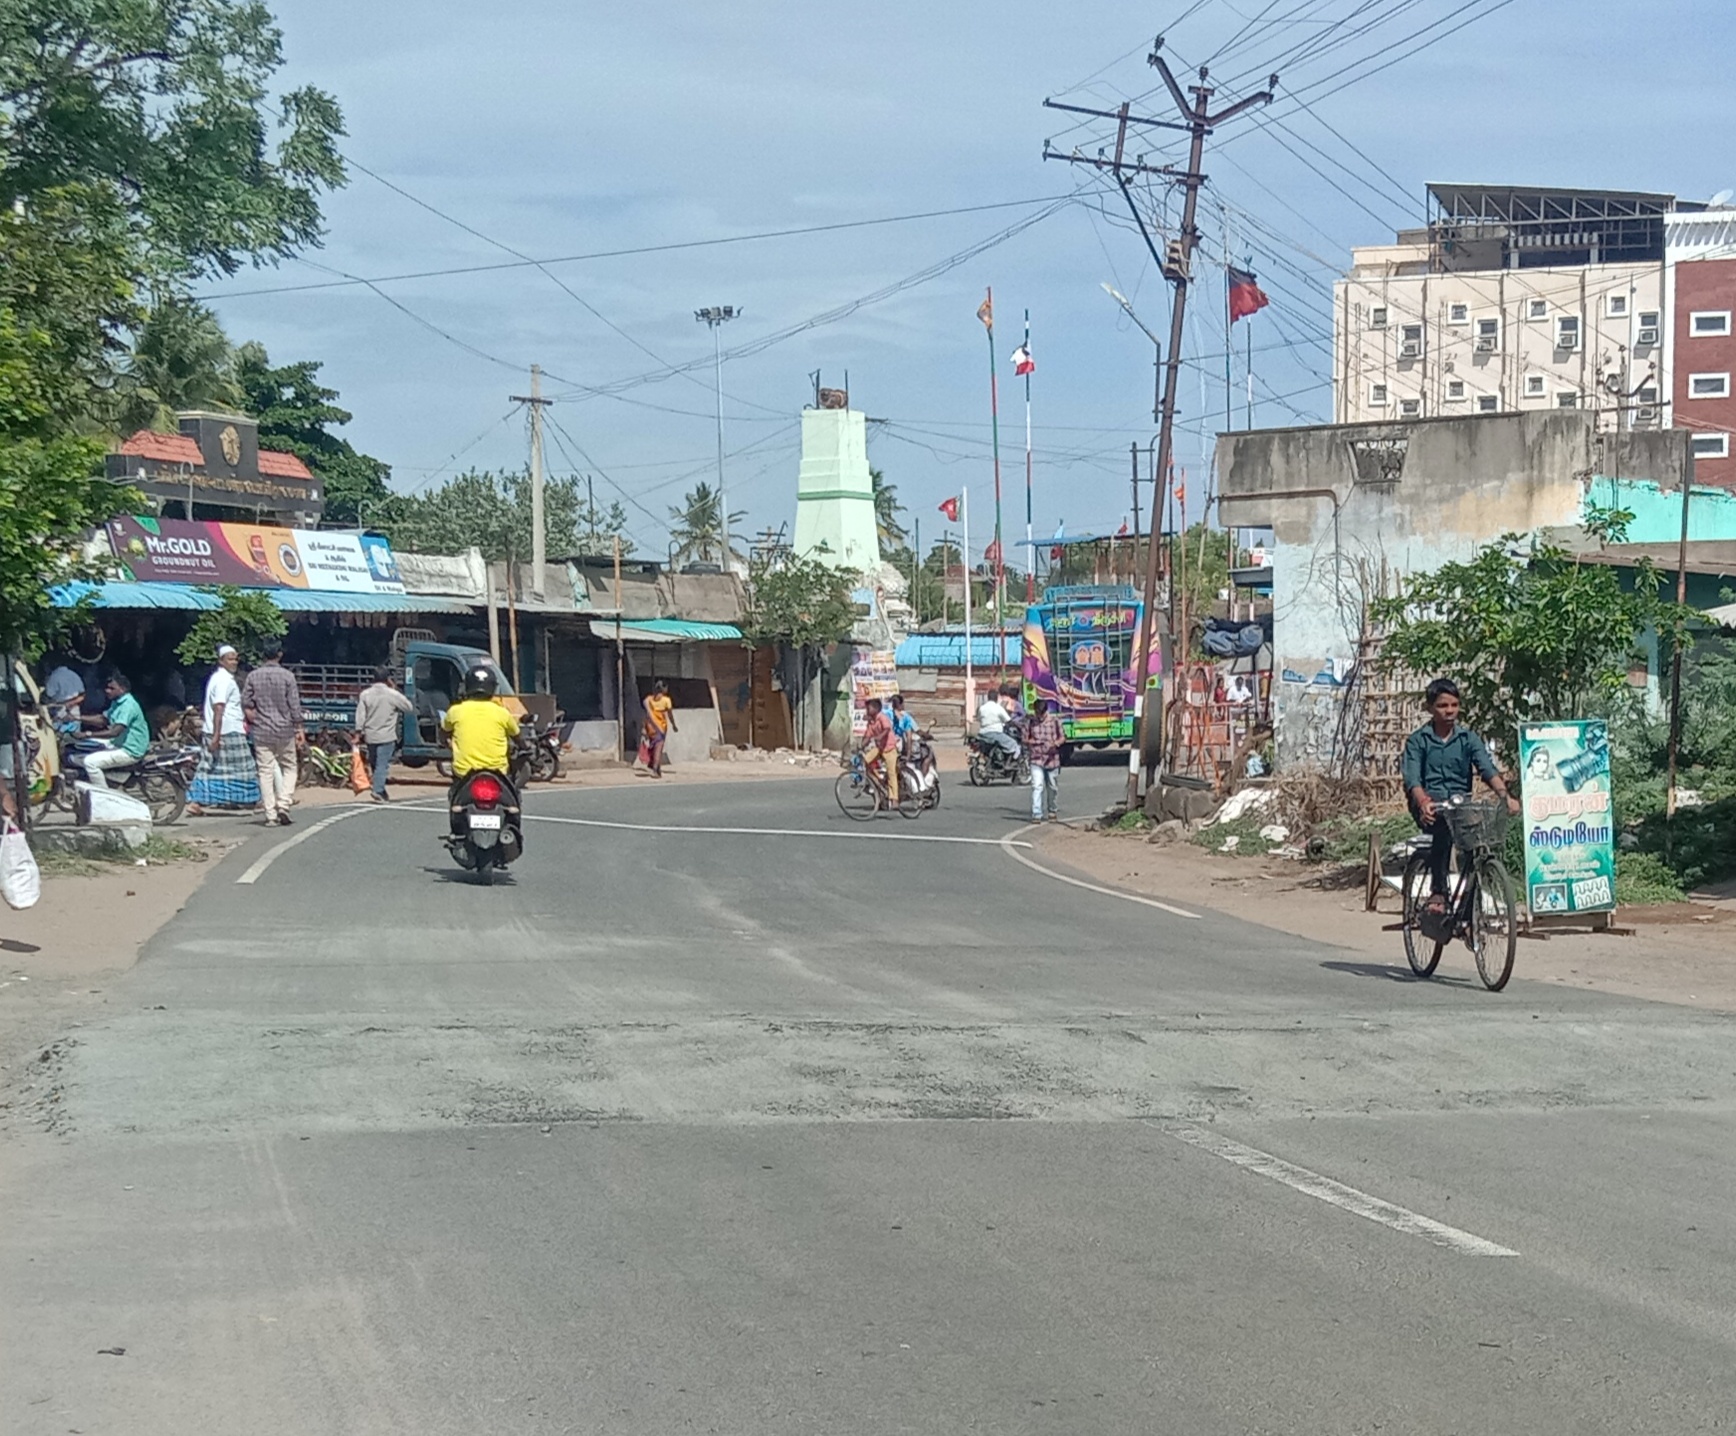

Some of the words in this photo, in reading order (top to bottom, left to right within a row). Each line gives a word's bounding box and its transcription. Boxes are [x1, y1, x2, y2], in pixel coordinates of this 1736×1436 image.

[144, 535, 212, 556] Mr.GOLD
[151, 555, 200, 567] GROUNDNUT
[201, 558, 217, 568] OIL
[1529, 782, 1610, 823] குமரன்
[1529, 821, 1610, 850] ஸ்டுடியோ
